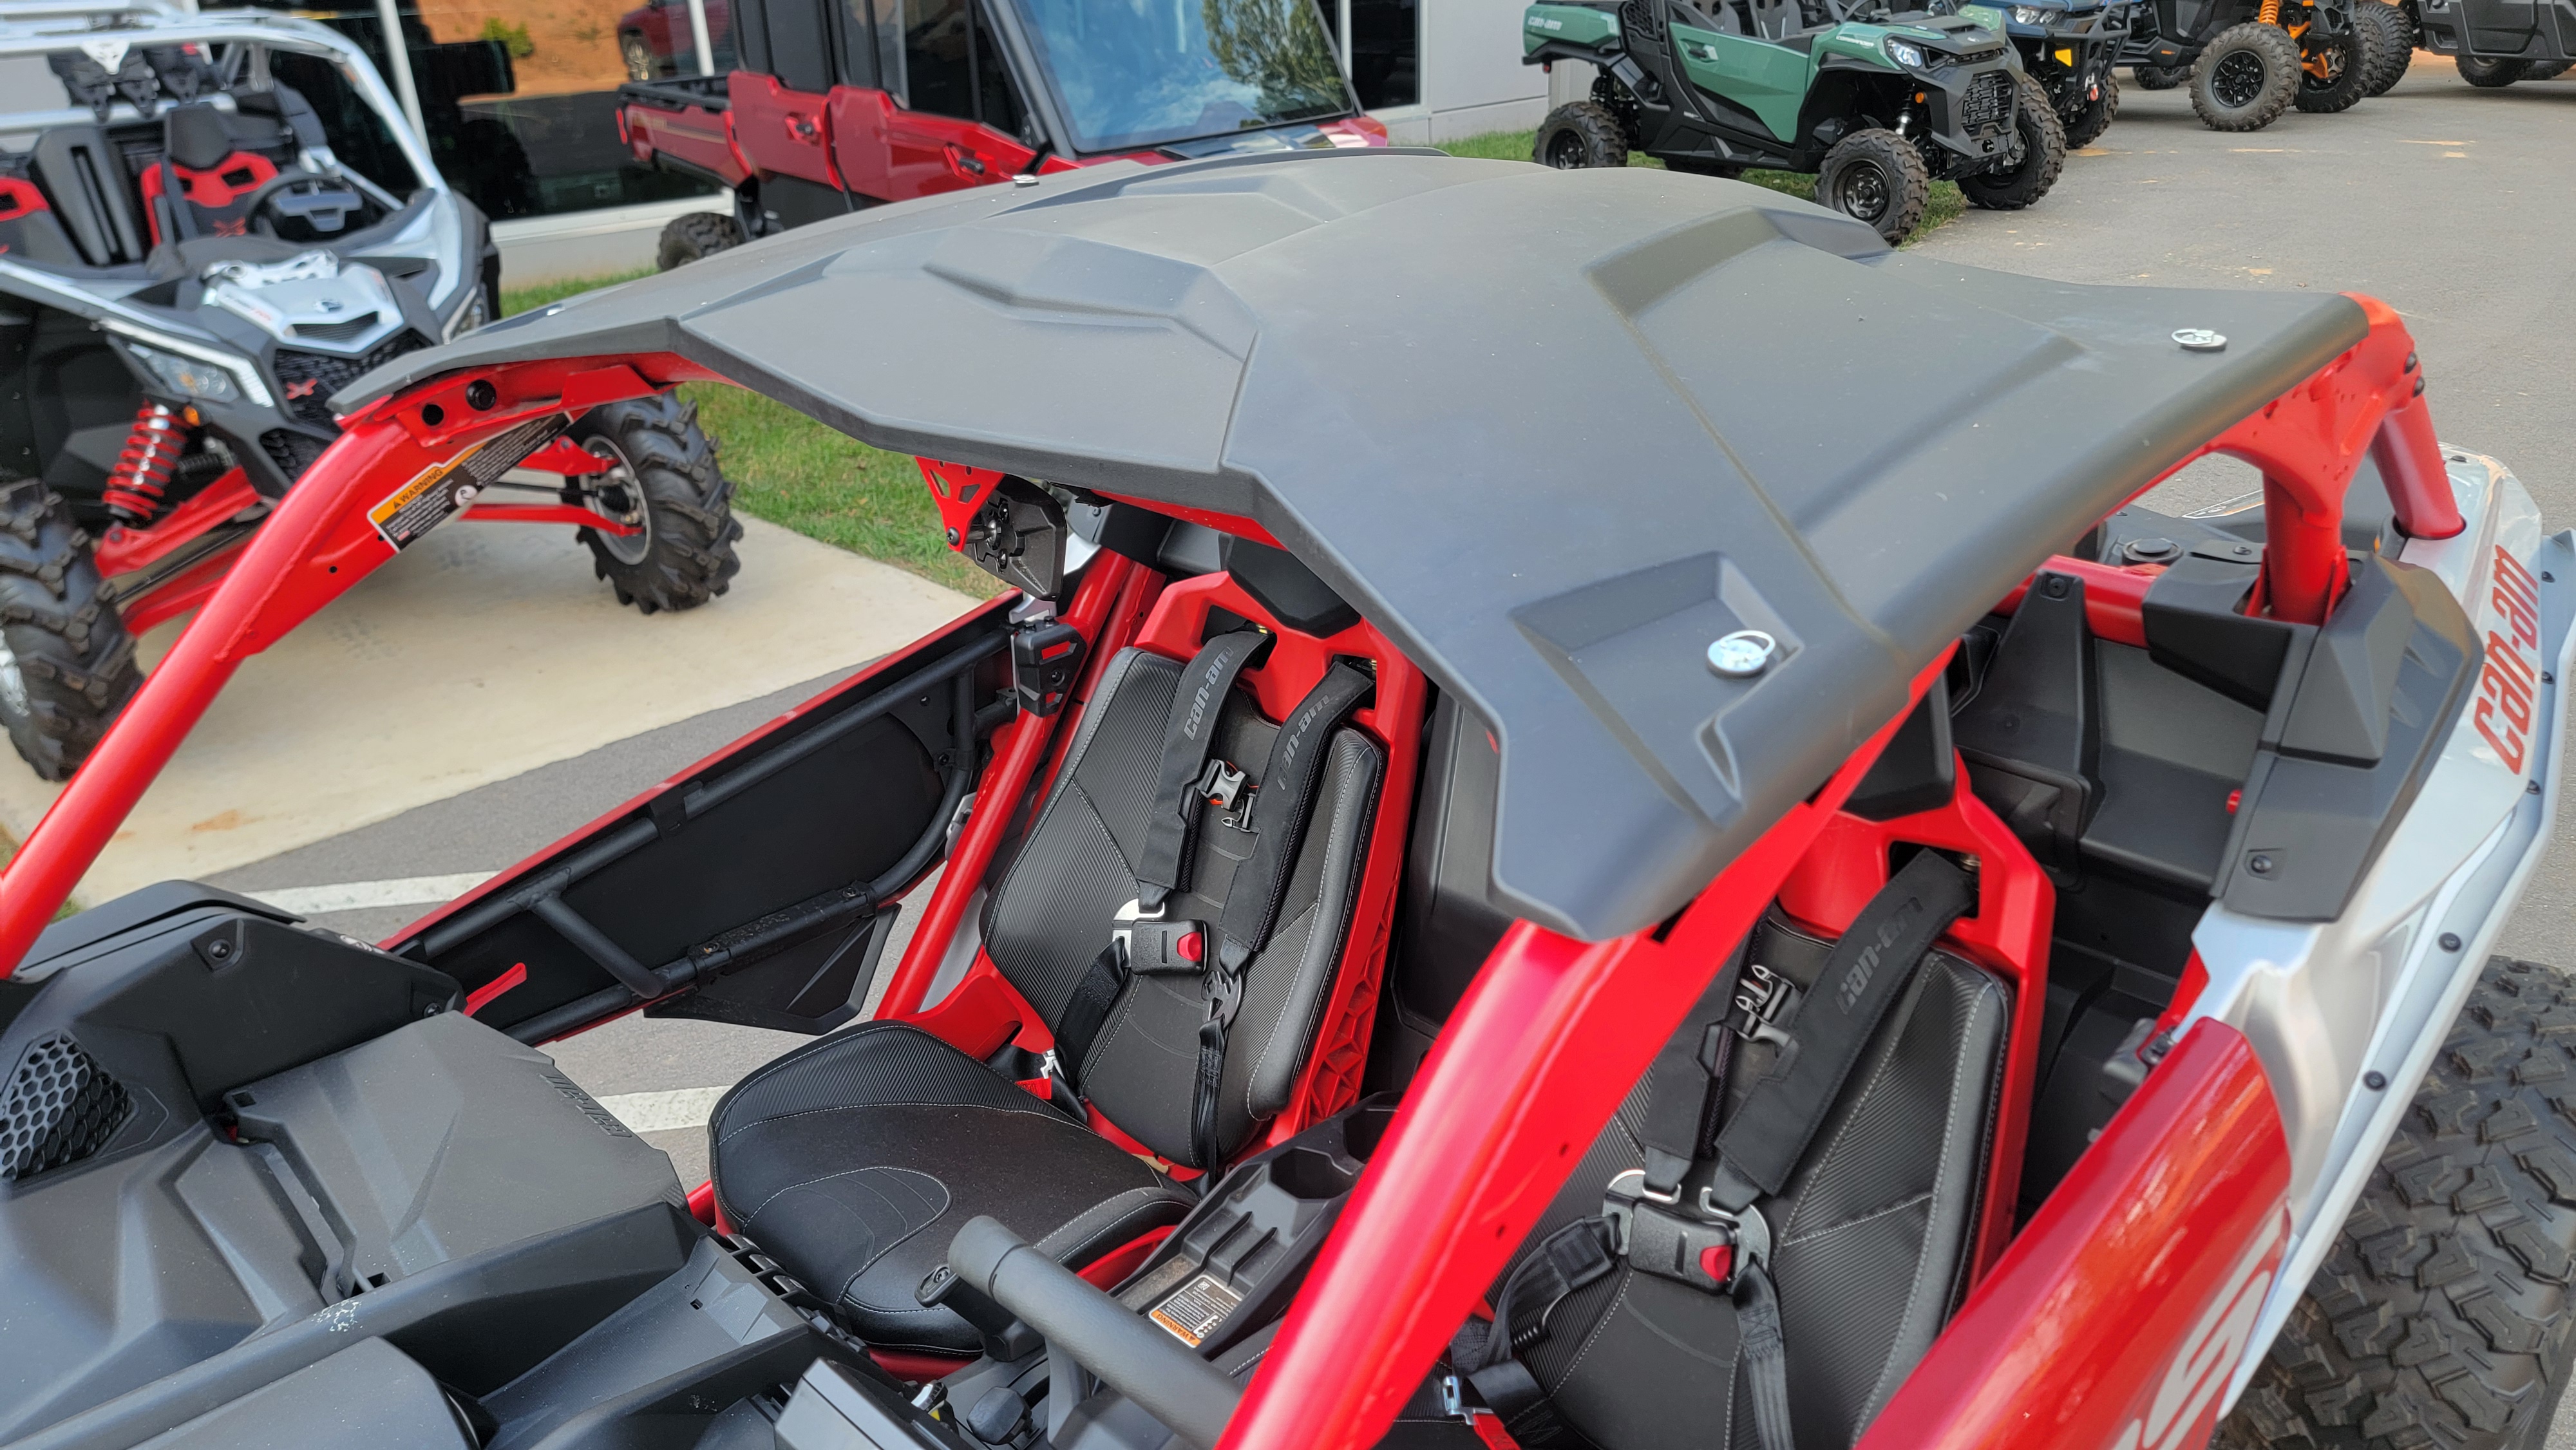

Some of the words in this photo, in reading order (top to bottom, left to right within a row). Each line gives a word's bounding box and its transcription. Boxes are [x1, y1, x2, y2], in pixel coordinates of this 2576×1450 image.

[400, 469, 443, 502] WARNING
[2474, 545, 2538, 775] can-am
[1184, 646, 1234, 740] can-am
[1156, 1313, 1189, 1338] WARNING
